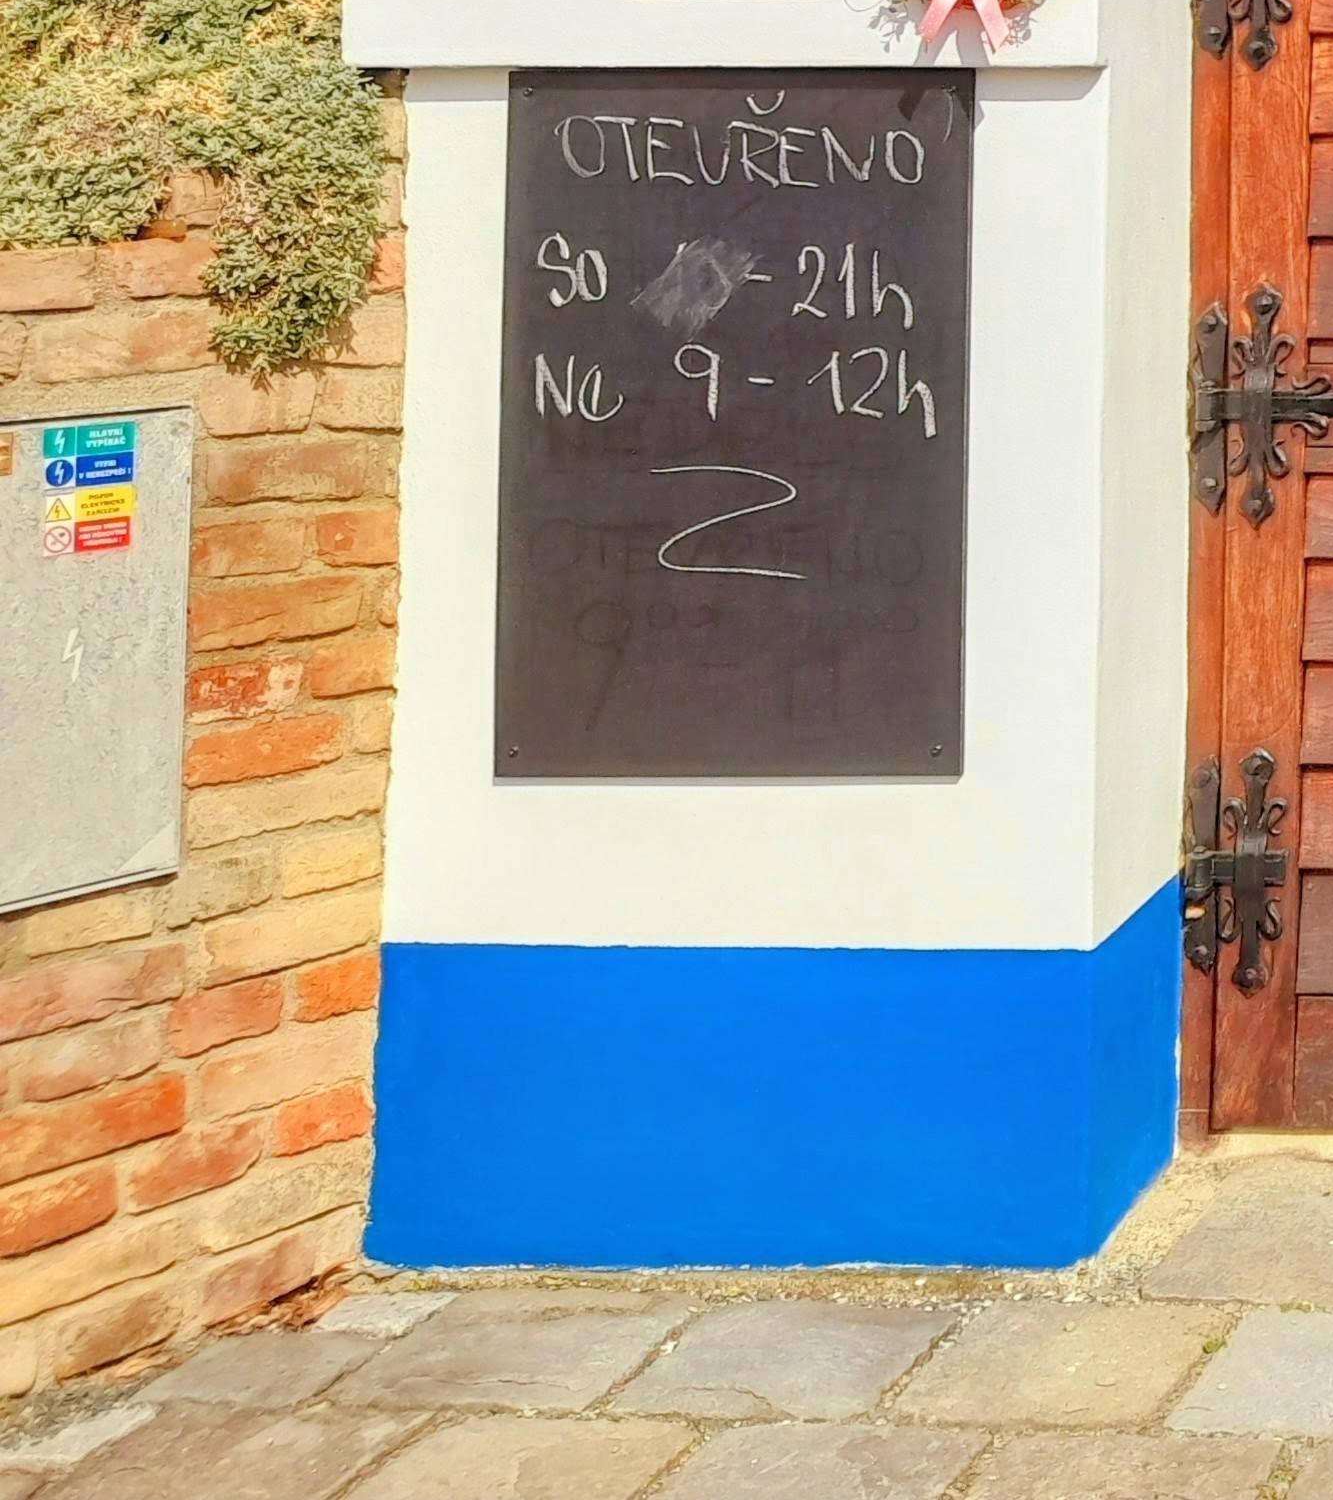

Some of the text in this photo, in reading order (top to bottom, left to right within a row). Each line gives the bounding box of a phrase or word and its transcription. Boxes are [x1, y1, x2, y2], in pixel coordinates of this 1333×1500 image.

[790, 242, 915, 331] 21h
[673, 343, 721, 422] 9
[806, 346, 938, 439] 12h
